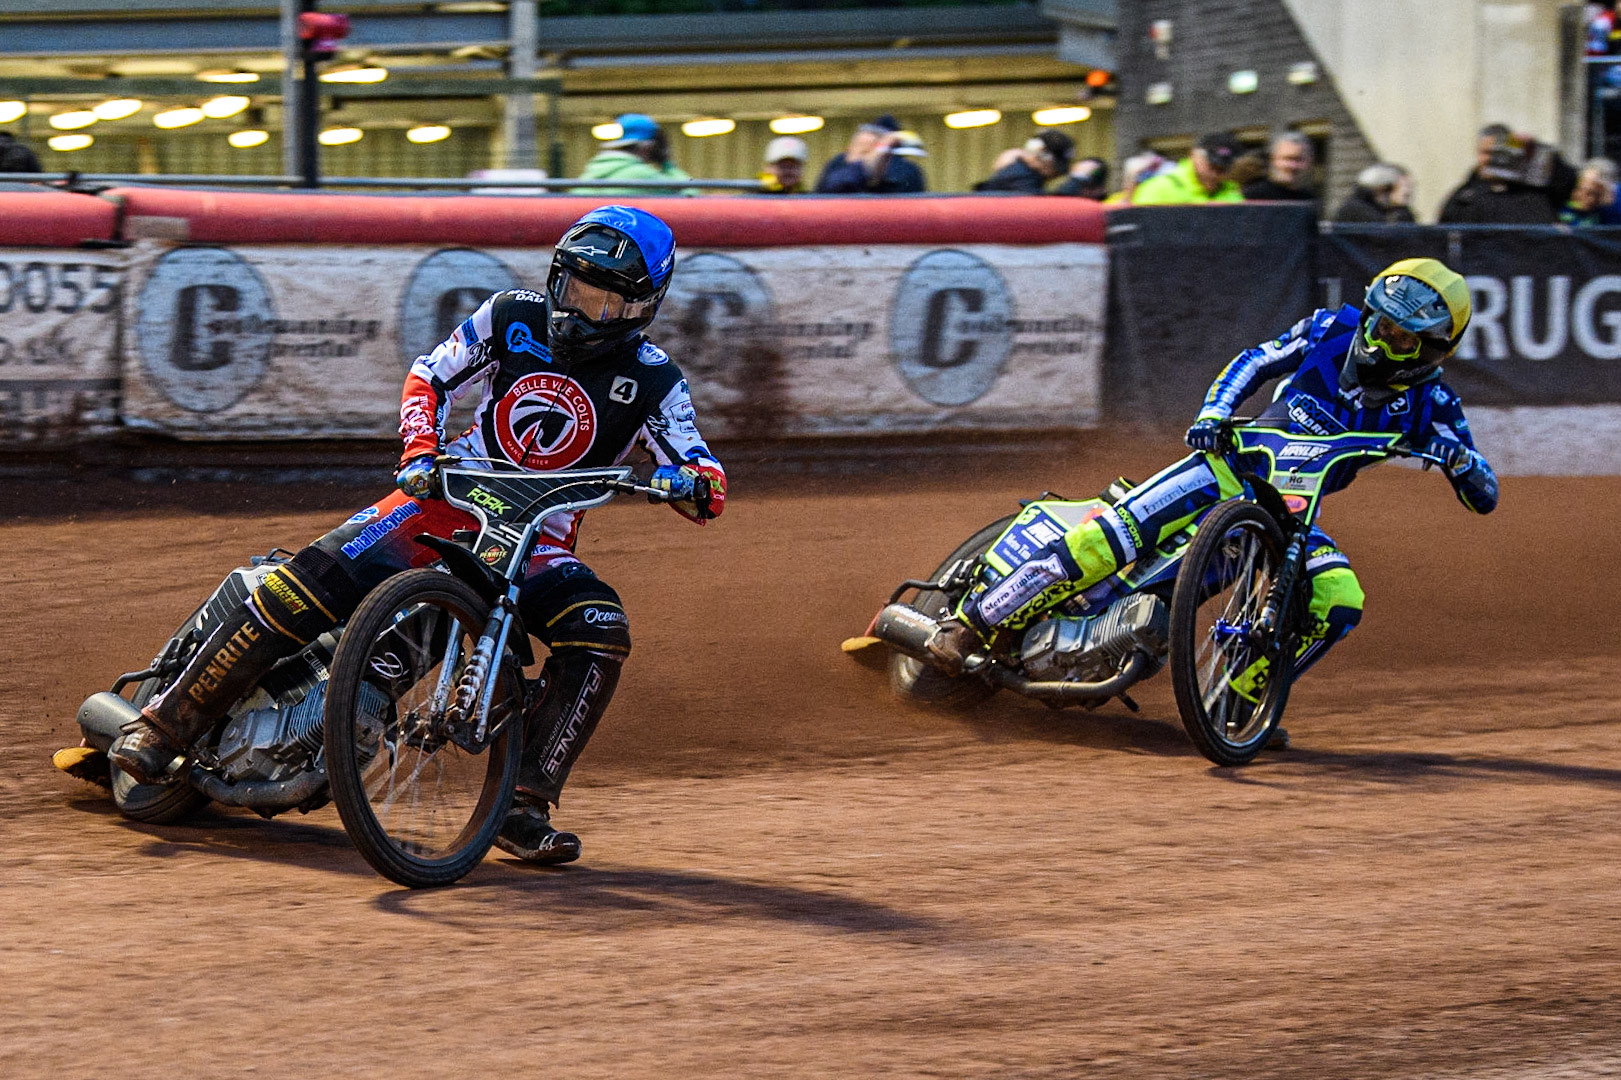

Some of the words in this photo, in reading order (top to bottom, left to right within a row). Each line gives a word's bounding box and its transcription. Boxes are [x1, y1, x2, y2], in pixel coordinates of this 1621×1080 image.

[513, 379, 548, 397] BELLE
[552, 381, 574, 397] VUE
[573, 396, 590, 431] COLTS
[614, 381, 634, 401] 4
[1390, 397, 1406, 411] 2
[466, 488, 513, 515] FORK
[341, 529, 377, 560] Metal
[366, 500, 422, 540] Recycling
[984, 592, 1010, 612] Metro
[1010, 569, 1040, 595] Timber
[188, 621, 260, 704] PENRITE
[547, 669, 601, 775] FLOUNCE
